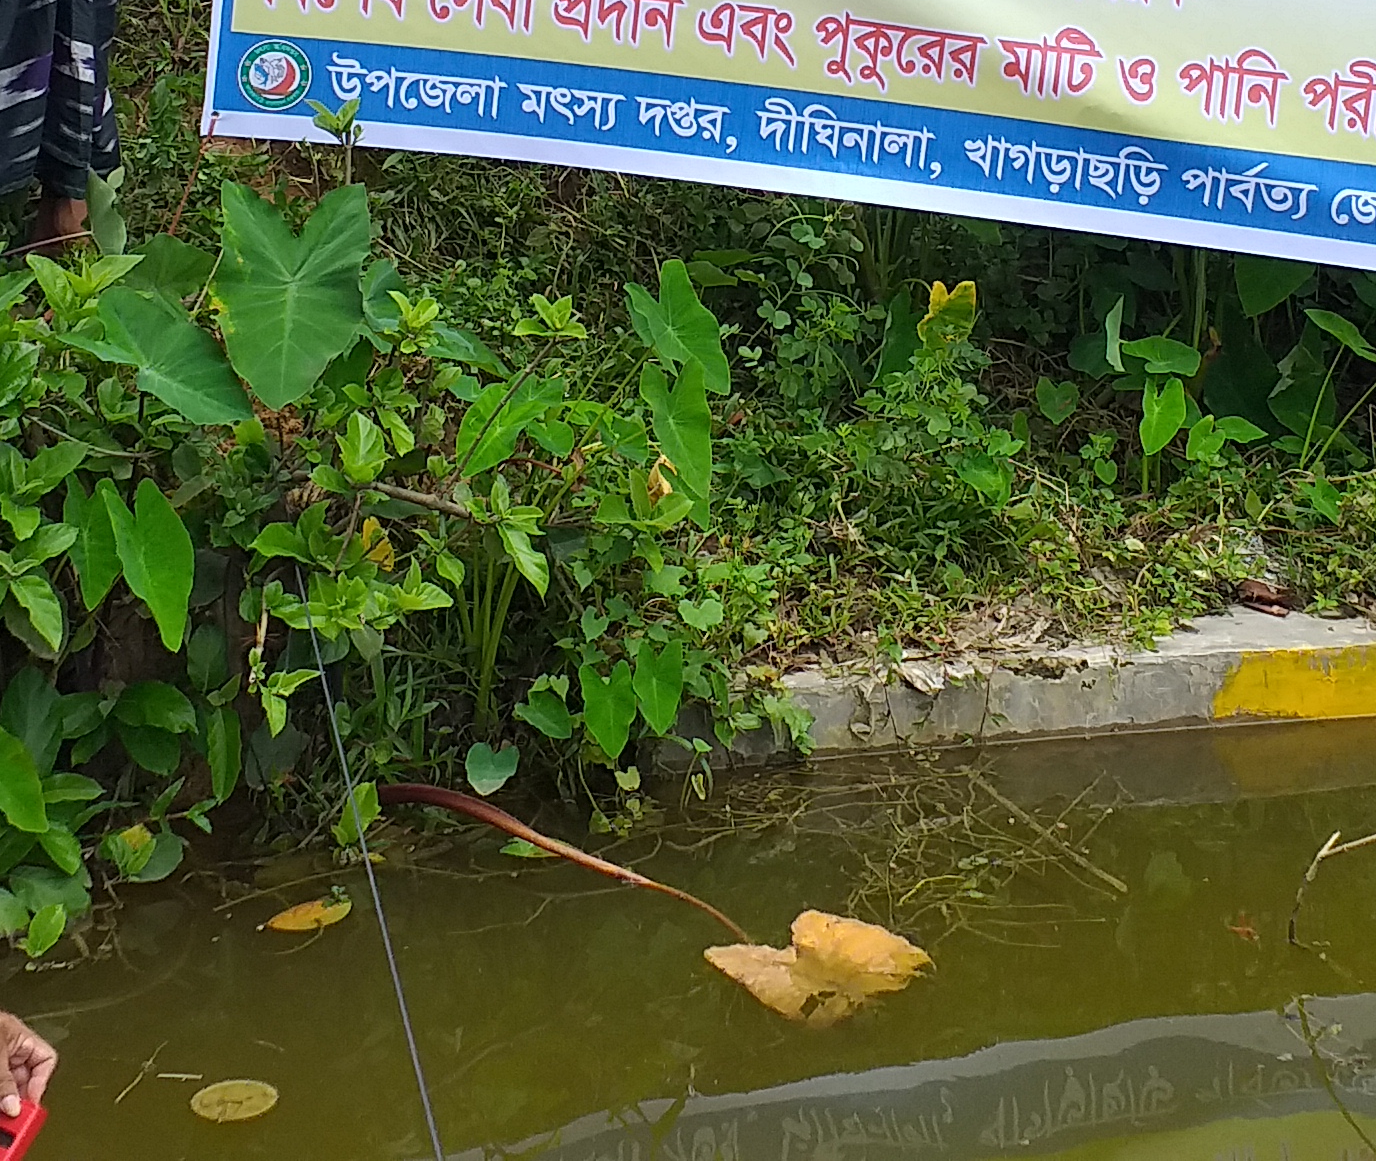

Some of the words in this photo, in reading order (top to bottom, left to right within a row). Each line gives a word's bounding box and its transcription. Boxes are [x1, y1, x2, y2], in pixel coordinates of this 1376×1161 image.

[699, 4, 794, 64] এবং
[816, 15, 985, 88] পুকুরের
[1000, 29, 1101, 95] মাটি
[1120, 60, 1154, 102] ও
[1180, 51, 1286, 120] পানি
[327, 53, 507, 118] উপজেলা
[518, 84, 625, 130] মৎস্য
[636, 97, 736, 153] দপ্তর,
[757, 98, 941, 178] দীঘিনালা,
[965, 136, 1166, 204] খাগড়াছড়ি
[1183, 163, 1318, 218] পার্বত্য
